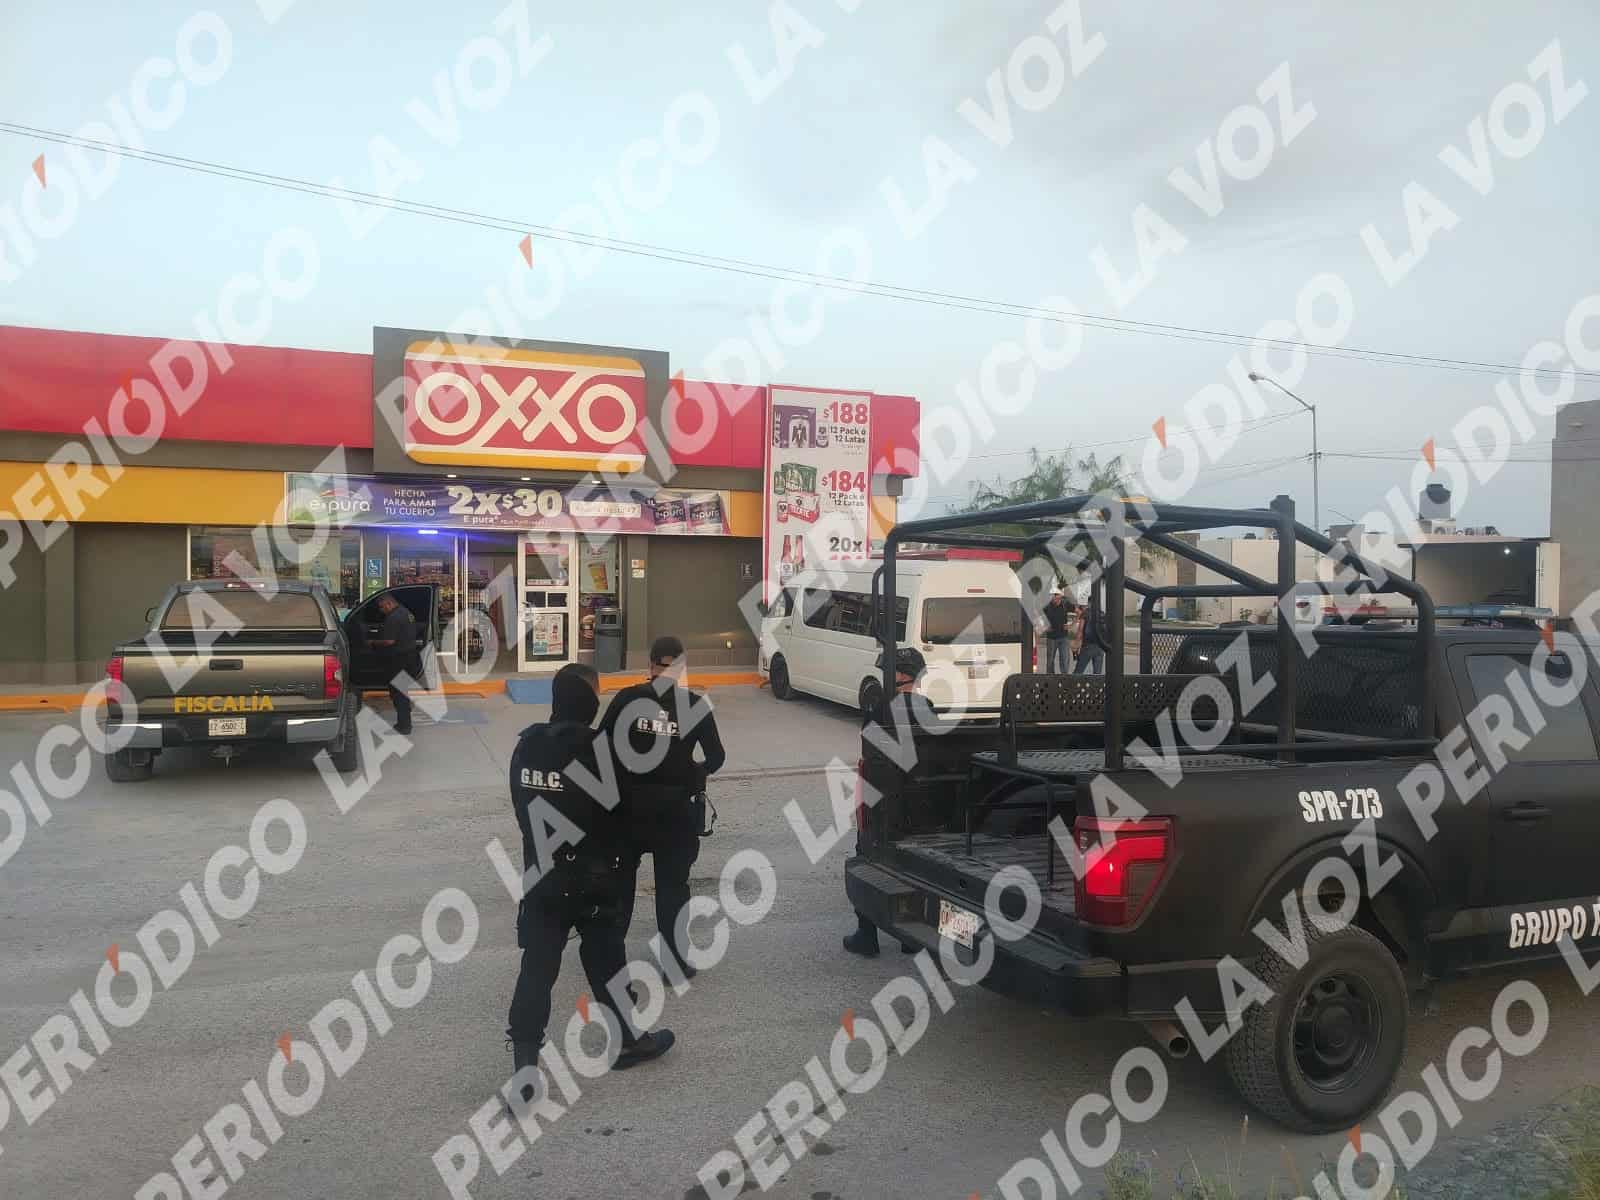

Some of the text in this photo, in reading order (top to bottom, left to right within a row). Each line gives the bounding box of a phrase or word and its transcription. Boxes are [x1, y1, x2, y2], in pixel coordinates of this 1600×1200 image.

[414, 371, 638, 445] OXXO
[823, 401, 868, 424] $188
[821, 470, 866, 492] $184
[384, 498, 437, 508] PARA AMAR
[394, 489, 426, 498] HECHA
[385, 506, 436, 517] TU CUERPO
[830, 537, 863, 552] 20x
[174, 690, 274, 713] FISCALÍA
[637, 717, 680, 734] G.R.C.
[521, 767, 564, 788] G.R.C.
[1298, 788, 1384, 823] SPR-273
[1509, 905, 1587, 949] GRUPO
